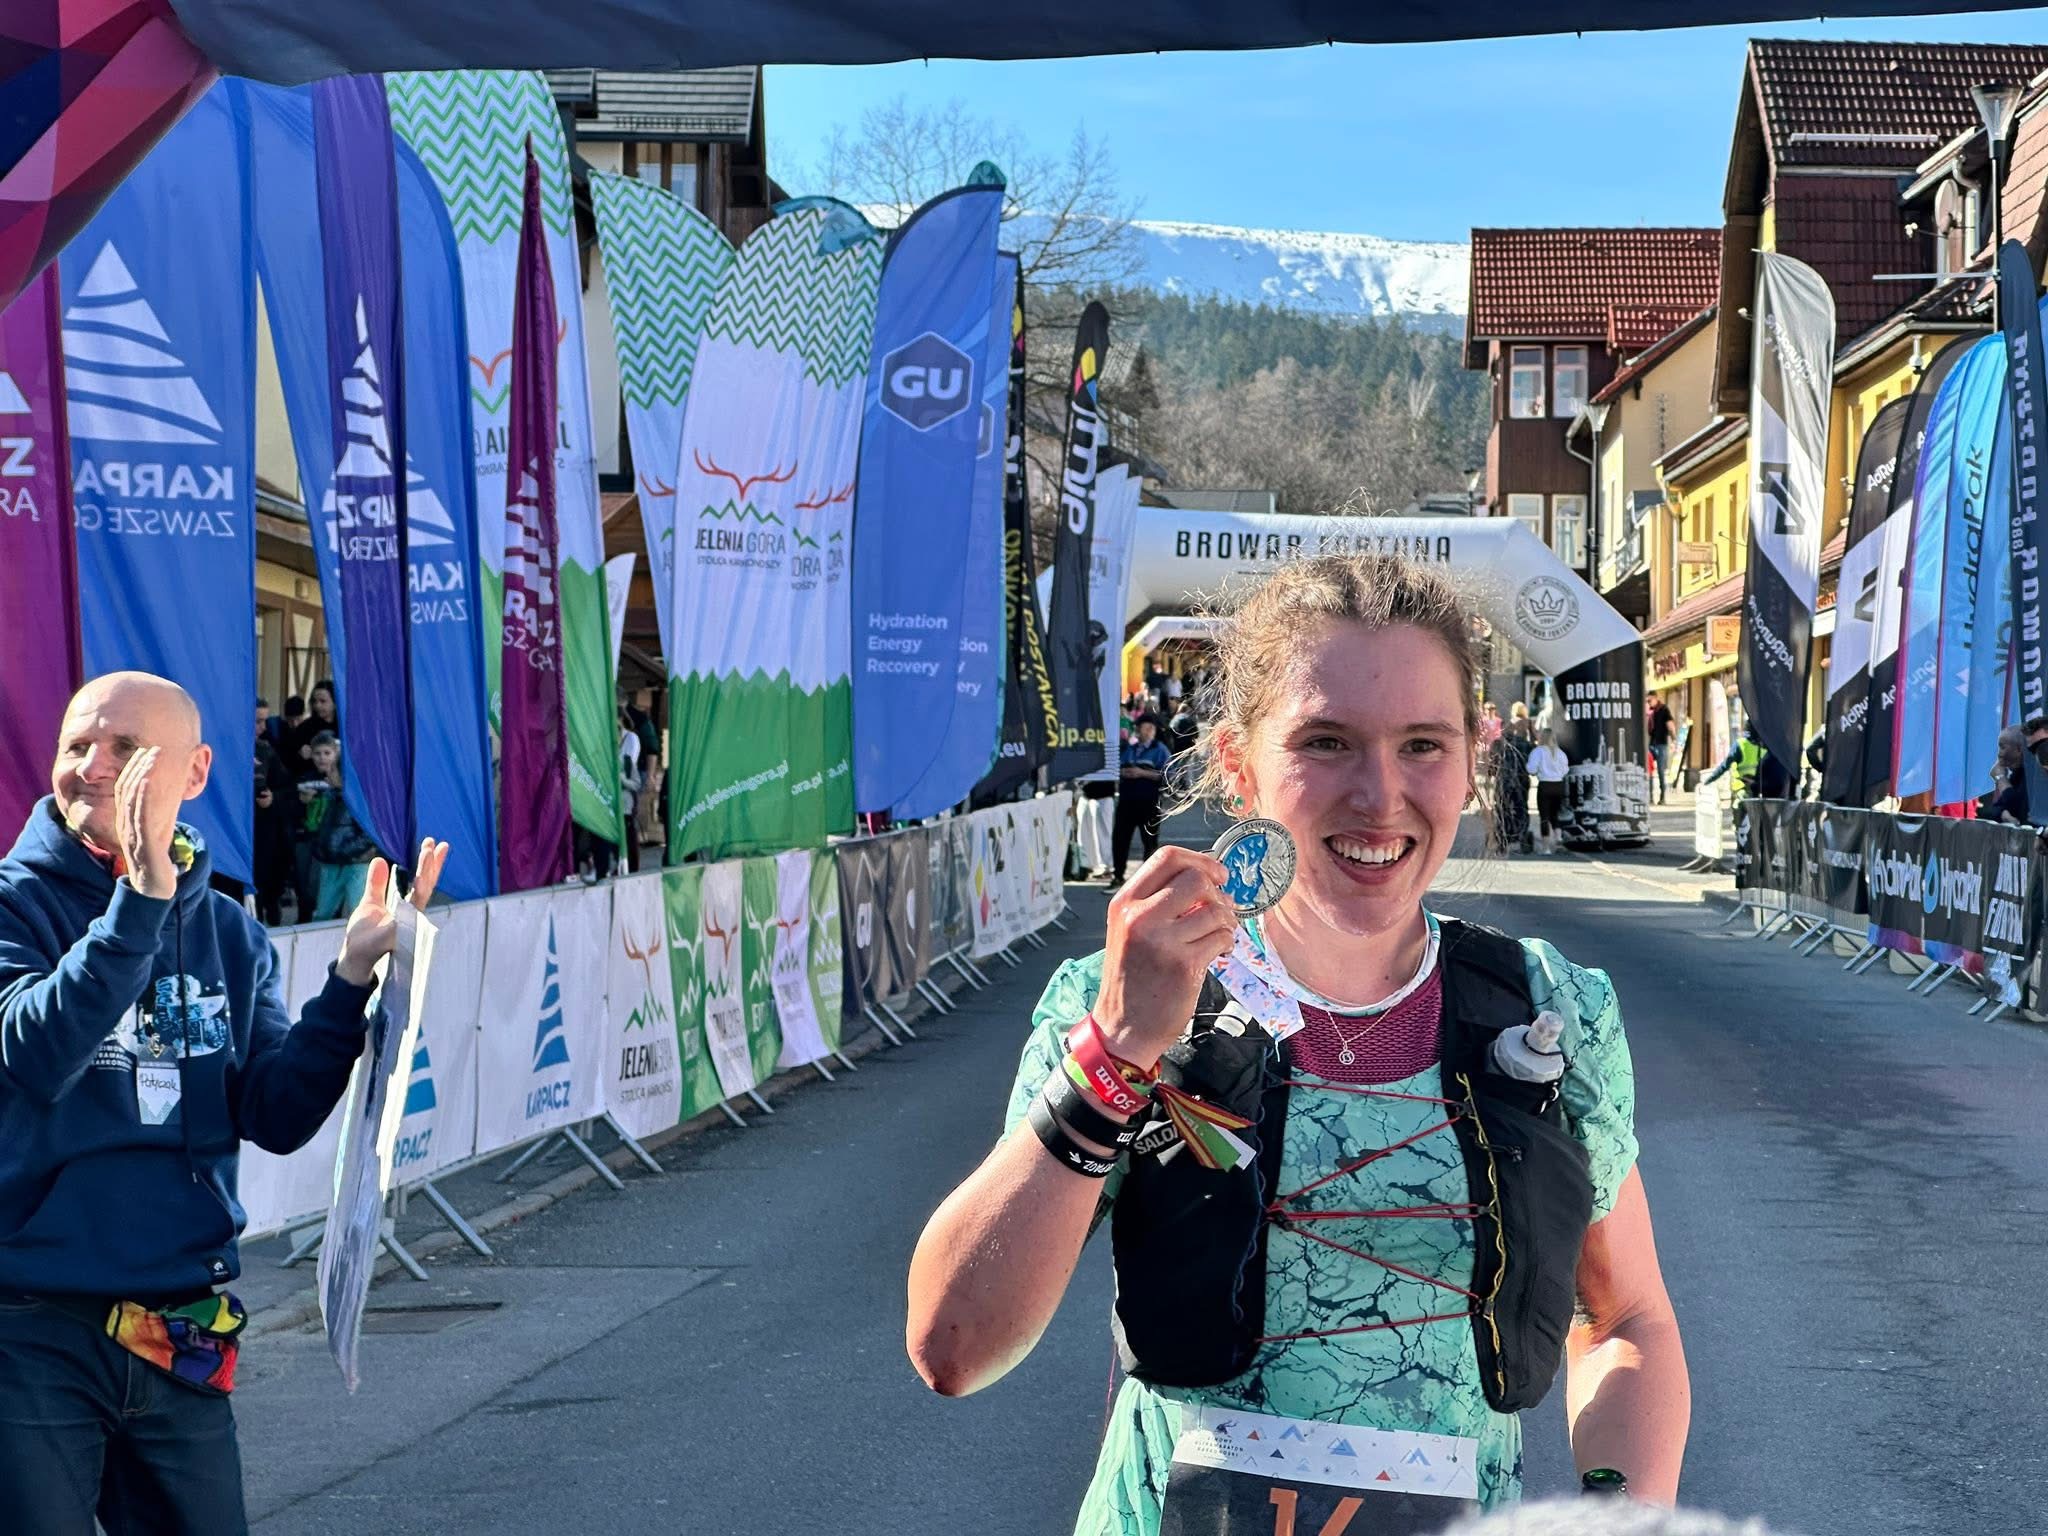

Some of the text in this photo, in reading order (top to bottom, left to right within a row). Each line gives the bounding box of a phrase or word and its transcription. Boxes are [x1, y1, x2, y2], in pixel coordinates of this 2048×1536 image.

[890, 366, 964, 400] GU
[695, 528, 743, 551] JELENIA
[1175, 530, 1301, 561] BROWAR
[868, 612, 948, 631] Hydration
[867, 635, 922, 654] Energy
[866, 657, 940, 677] Recovery
[1566, 682, 1631, 700] BROWAR
[1096, 1065, 1120, 1097] km
[526, 1080, 572, 1121] KARPACZ
[1113, 1093, 1137, 1111] 50
